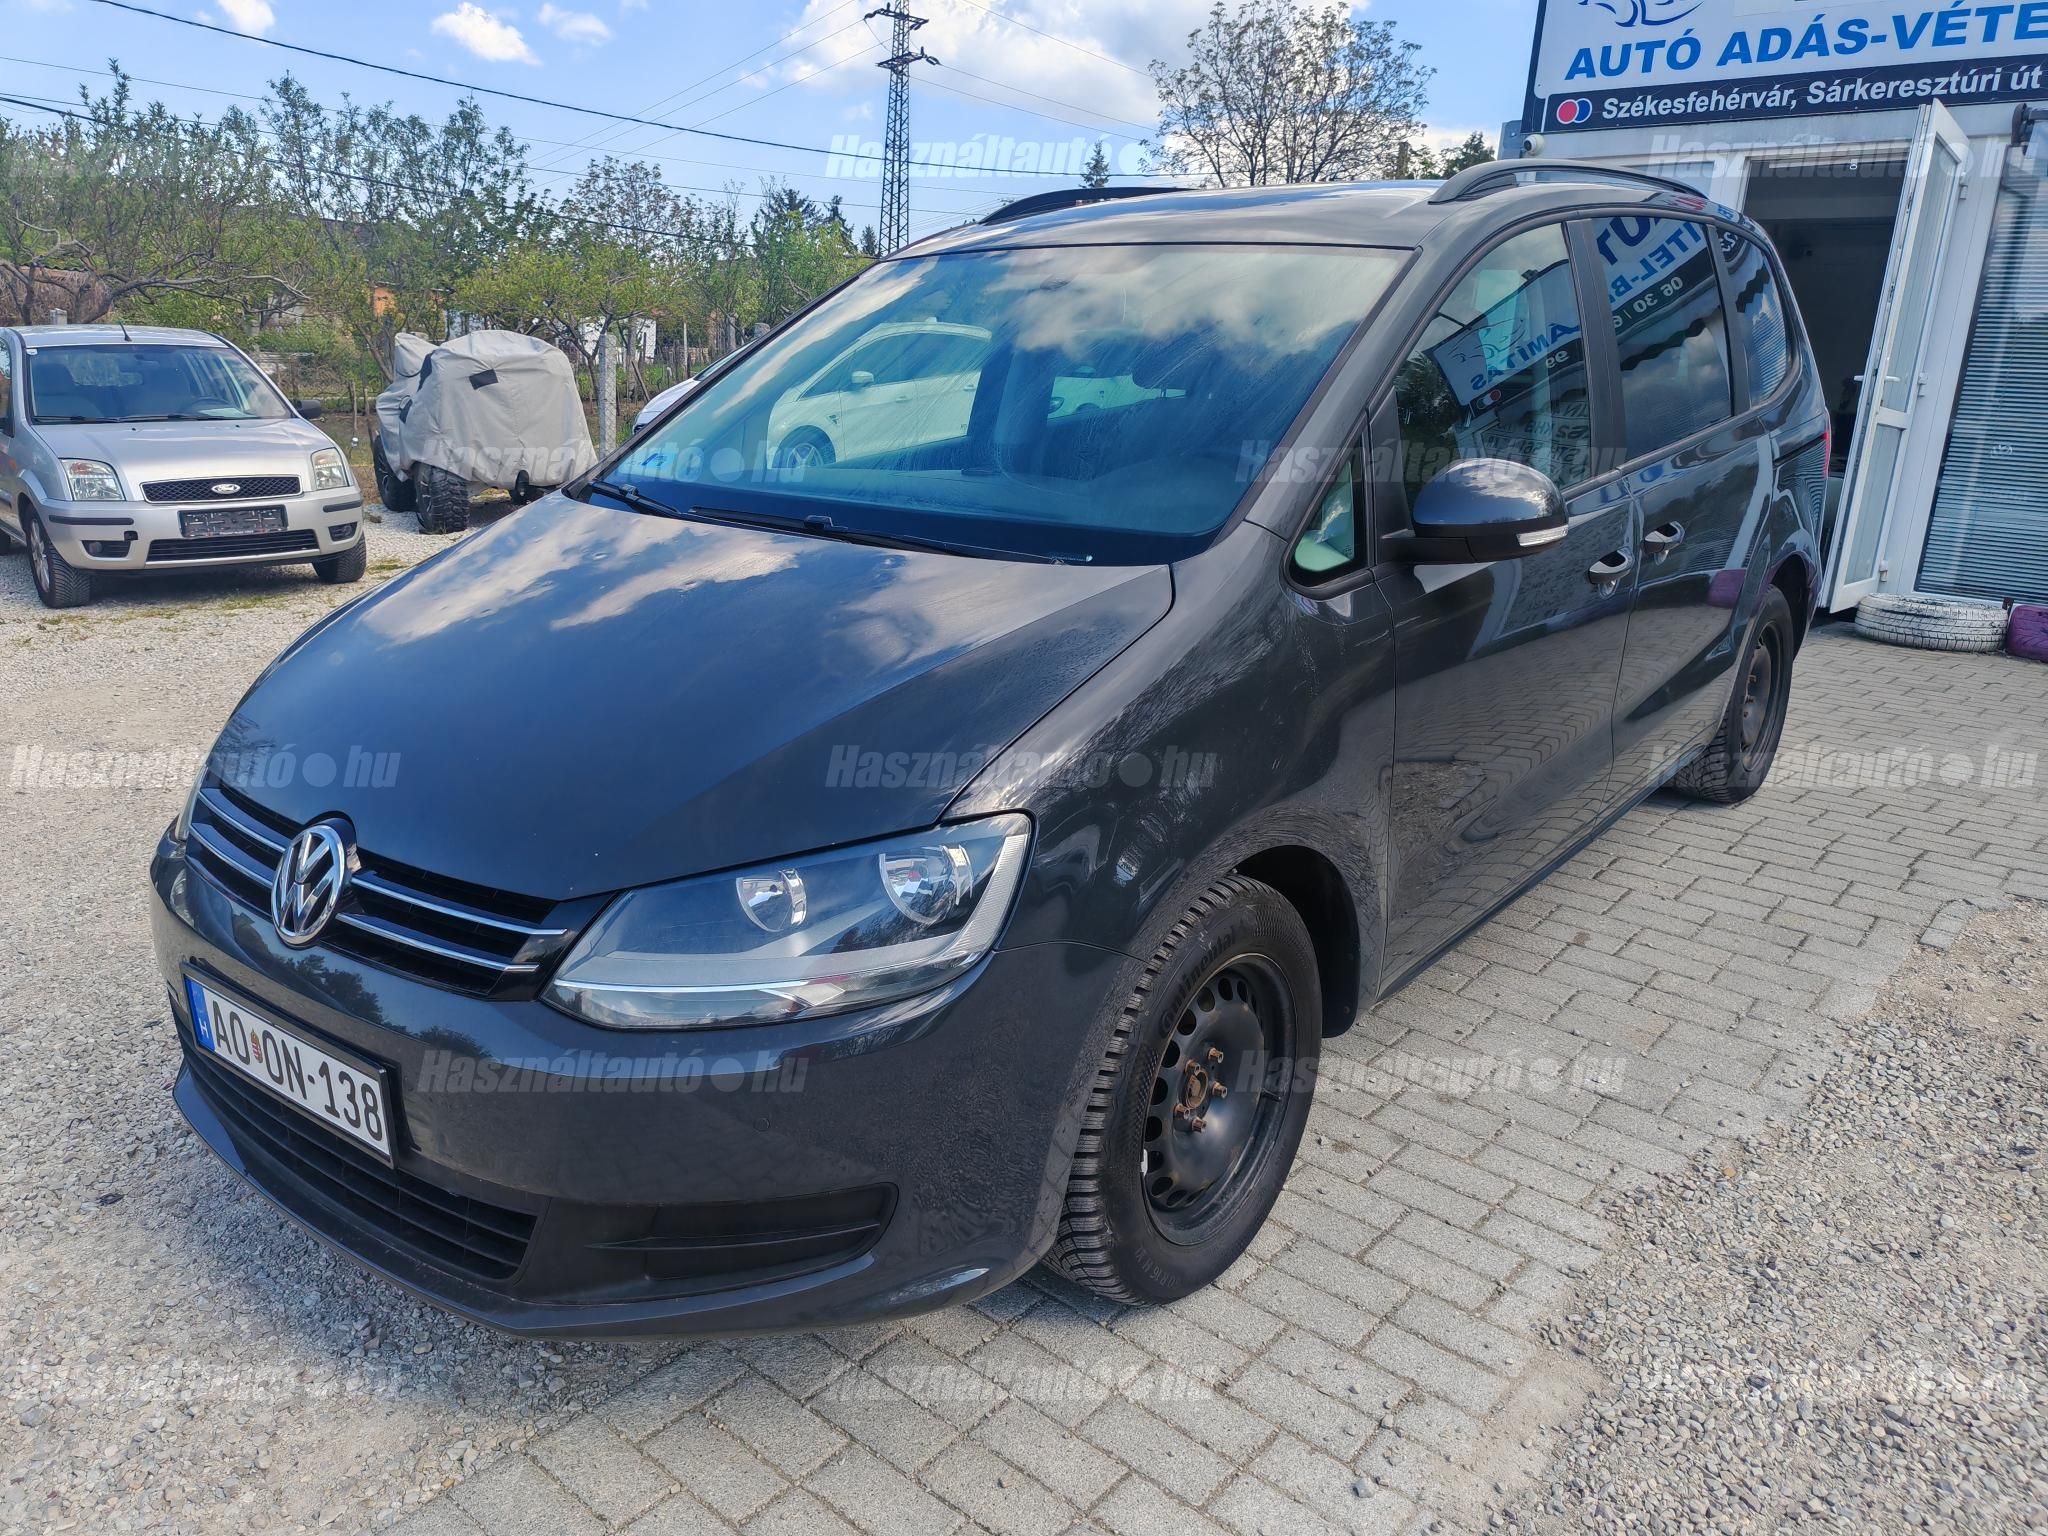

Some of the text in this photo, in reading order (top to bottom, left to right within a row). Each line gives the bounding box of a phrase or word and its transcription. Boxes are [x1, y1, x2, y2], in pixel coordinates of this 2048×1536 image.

[1565, 28, 1701, 80] AUTÓ
[1603, 65, 2043, 120] Székesfehérvár, Sárkeresztúri út
